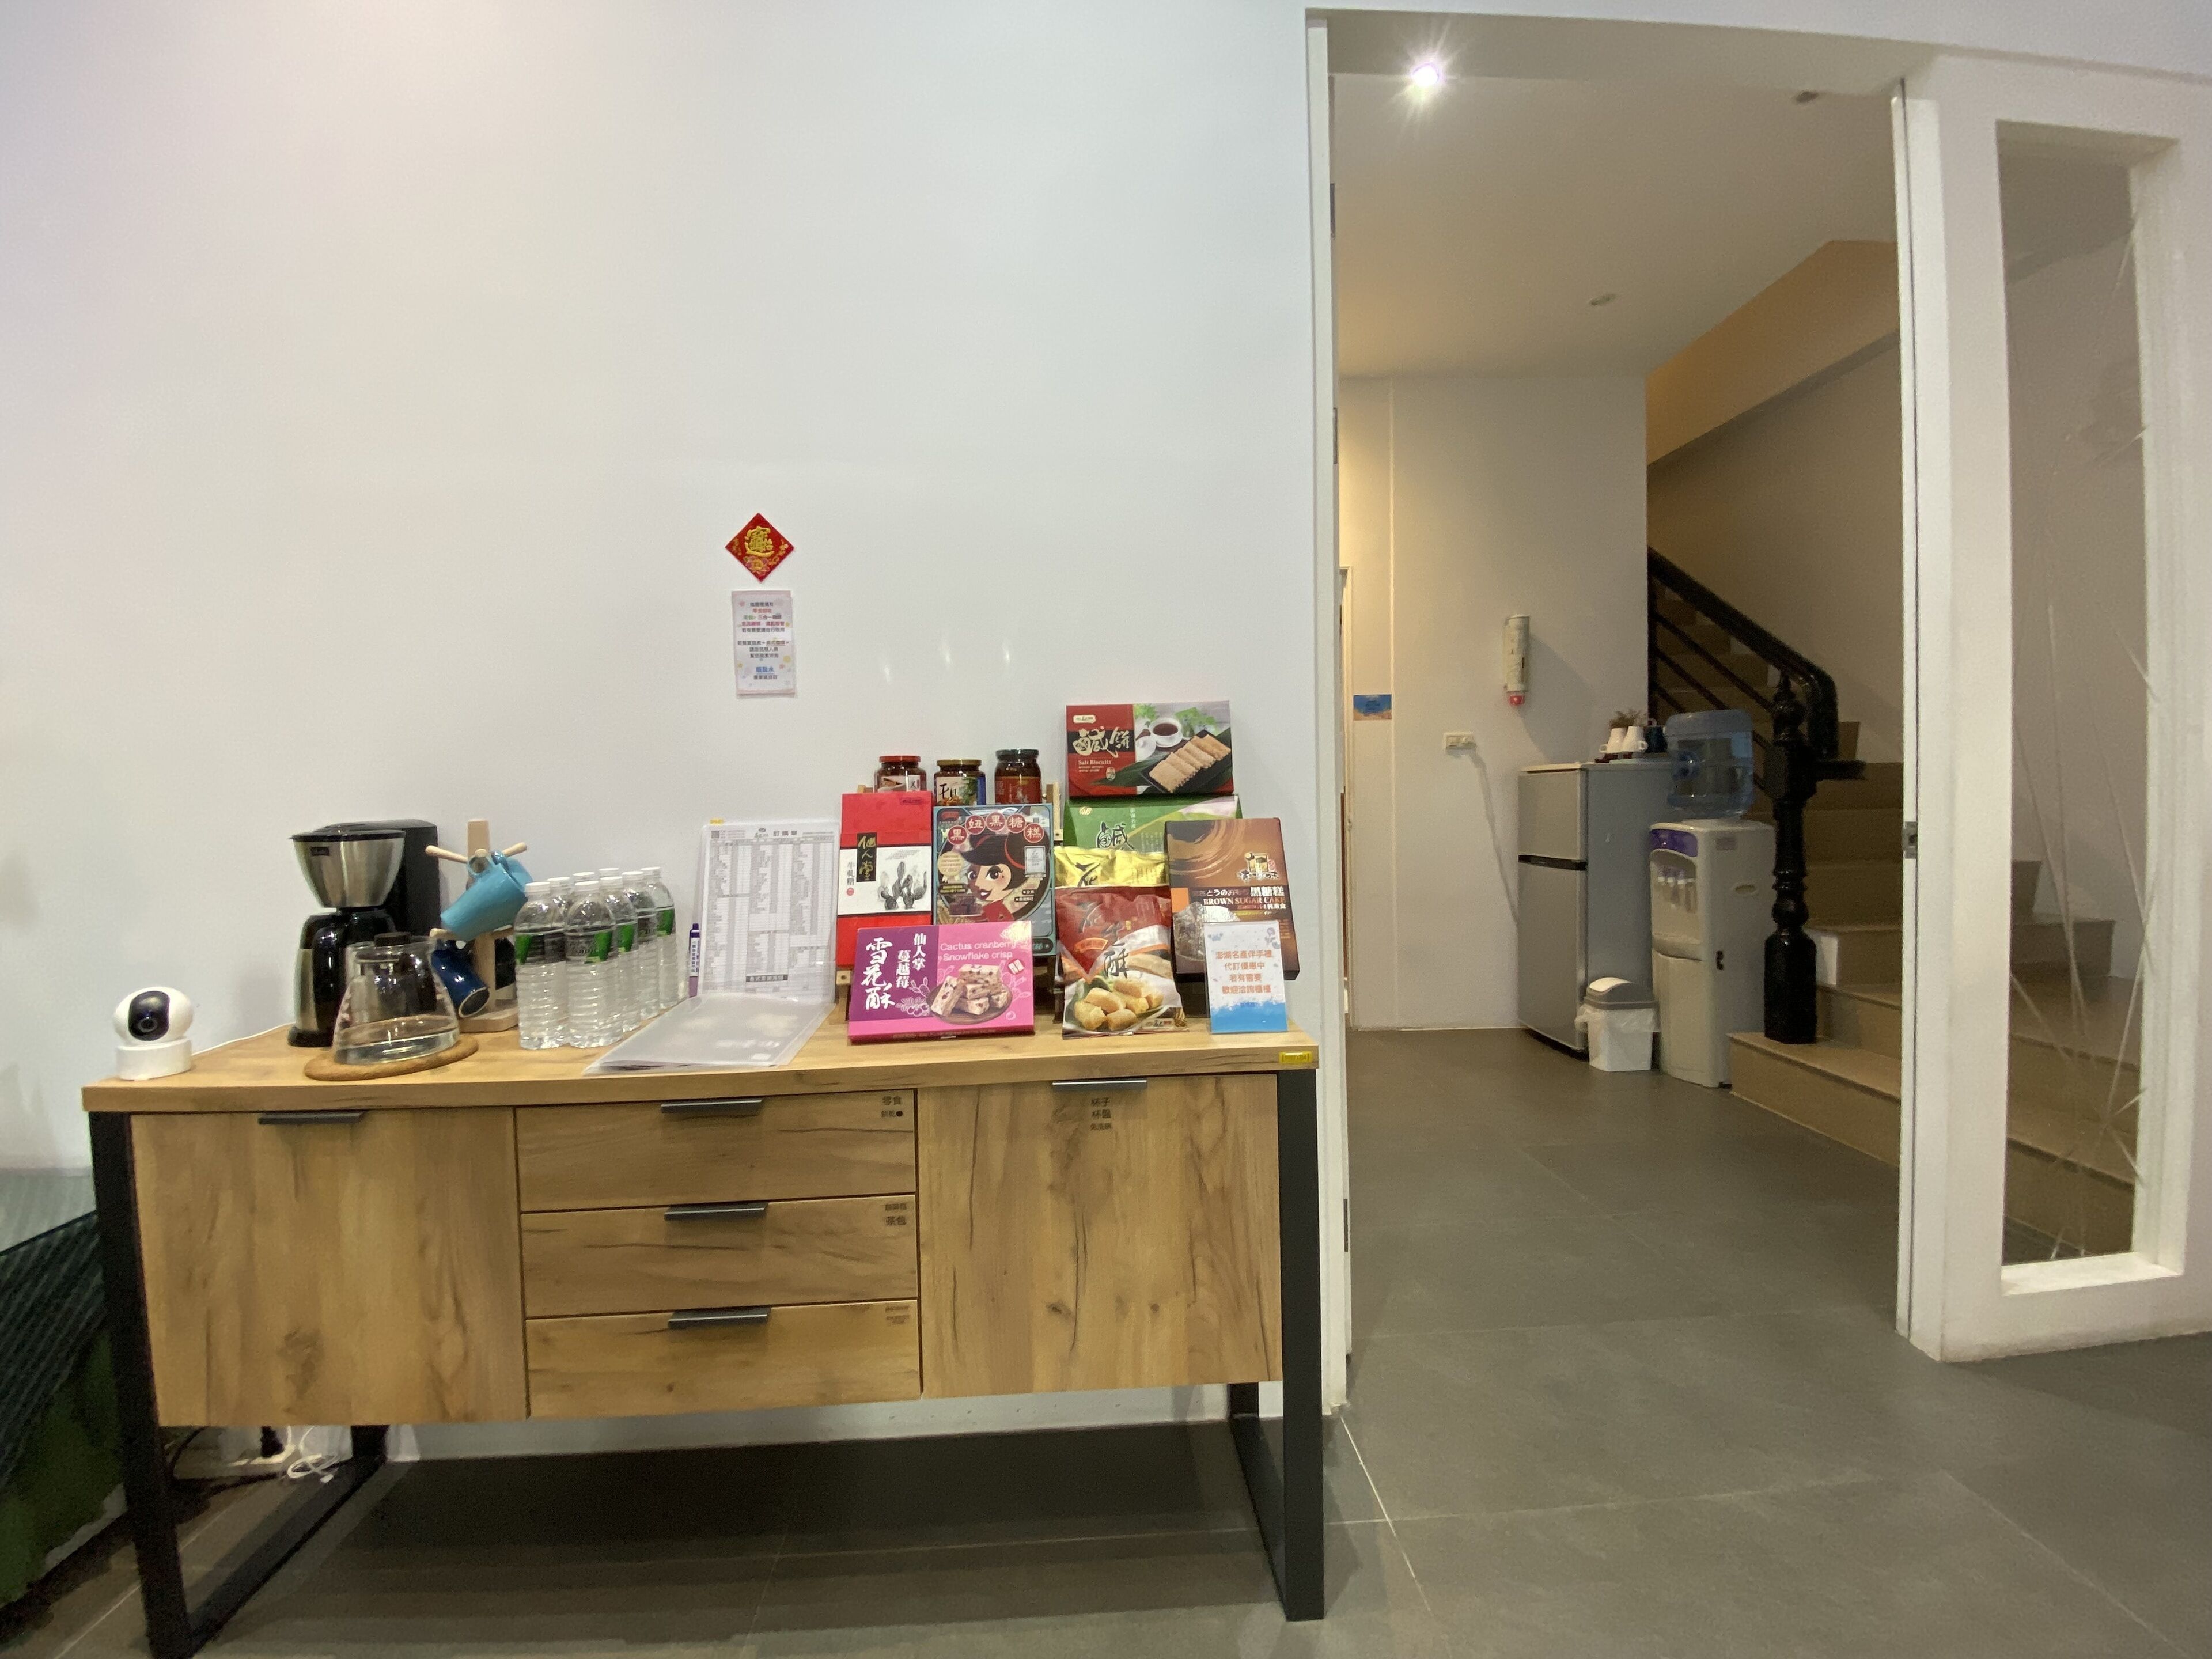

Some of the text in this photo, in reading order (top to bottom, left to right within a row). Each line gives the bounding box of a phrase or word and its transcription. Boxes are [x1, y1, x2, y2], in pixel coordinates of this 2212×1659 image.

[1203, 895, 1286, 905] BROWN SUGAR CAKE
[940, 940, 1016, 951] Cactus cranberry
[912, 933, 926, 971] 仙人掌
[943, 951, 1013, 961] Snowflake crisp
[861, 937, 895, 1010] 雪花酥
[896, 951, 911, 988] 蔓越莓
[1229, 973, 1262, 982] 若有需要
